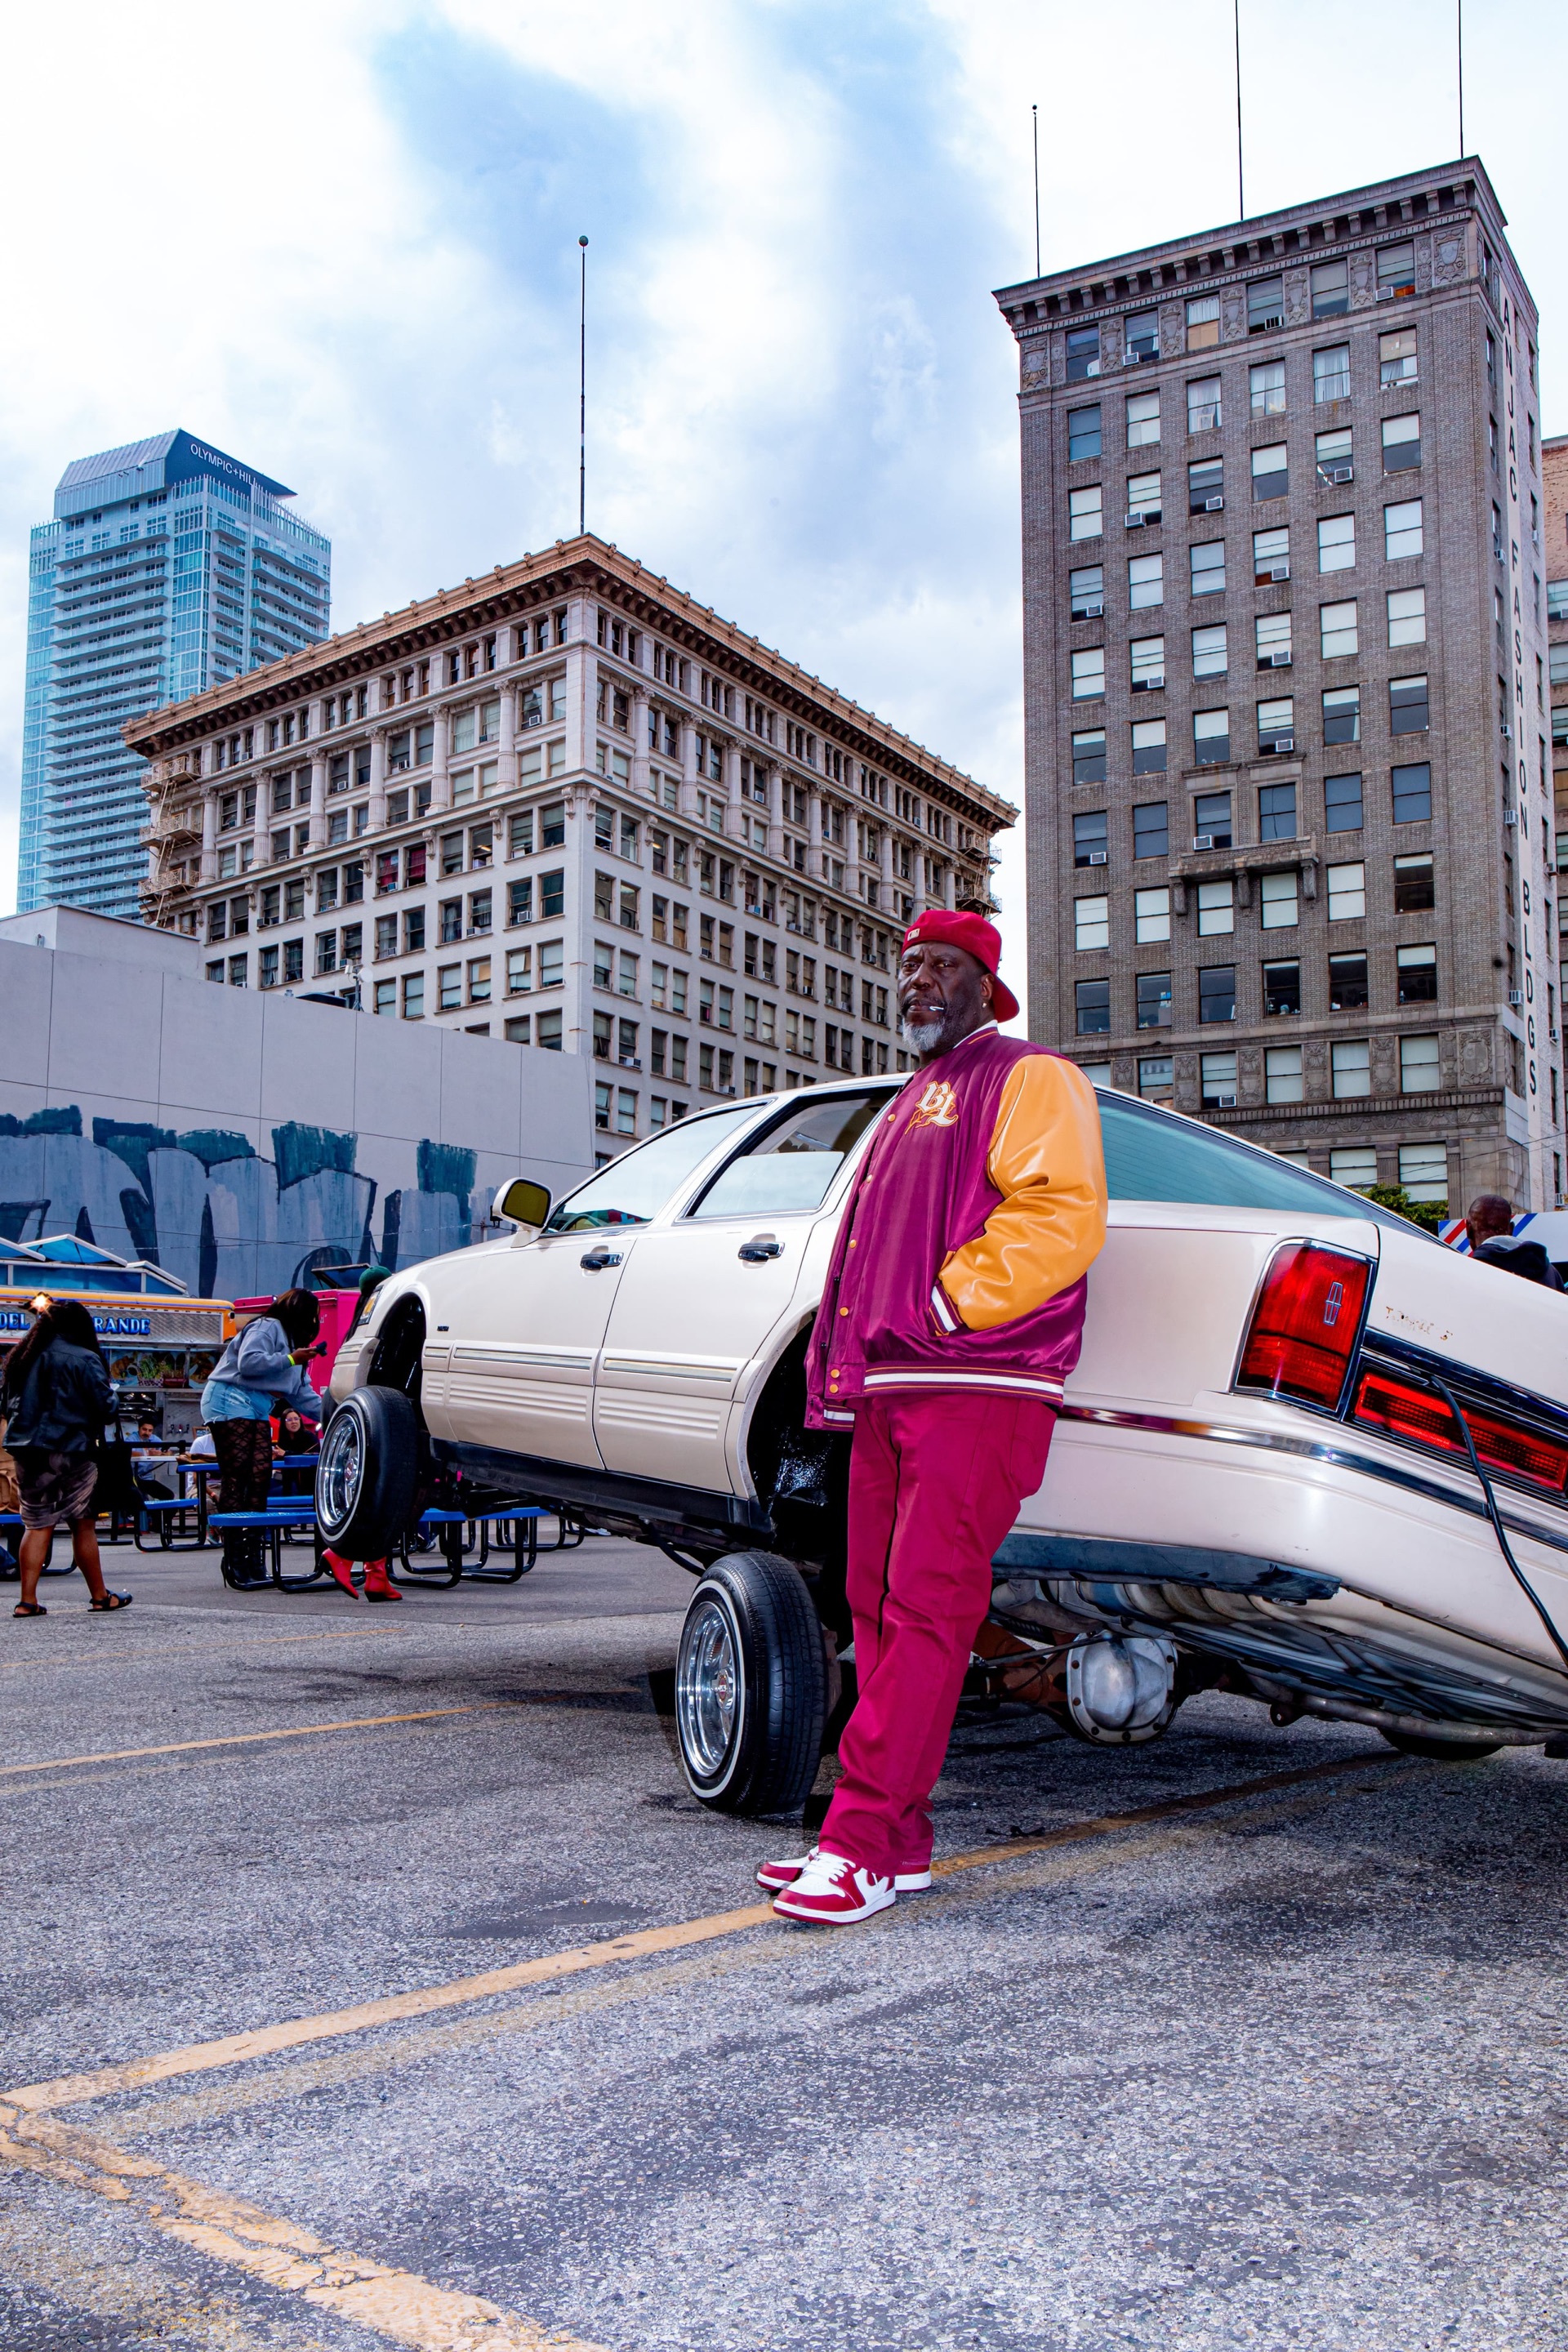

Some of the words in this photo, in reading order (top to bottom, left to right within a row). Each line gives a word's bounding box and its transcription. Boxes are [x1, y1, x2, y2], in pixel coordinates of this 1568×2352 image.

[1503, 297, 1517, 502] ANJAC
[1511, 538, 1528, 840] FASHION
[0, 1312, 30, 1330] DEL
[93, 1316, 151, 1335] RANDE
